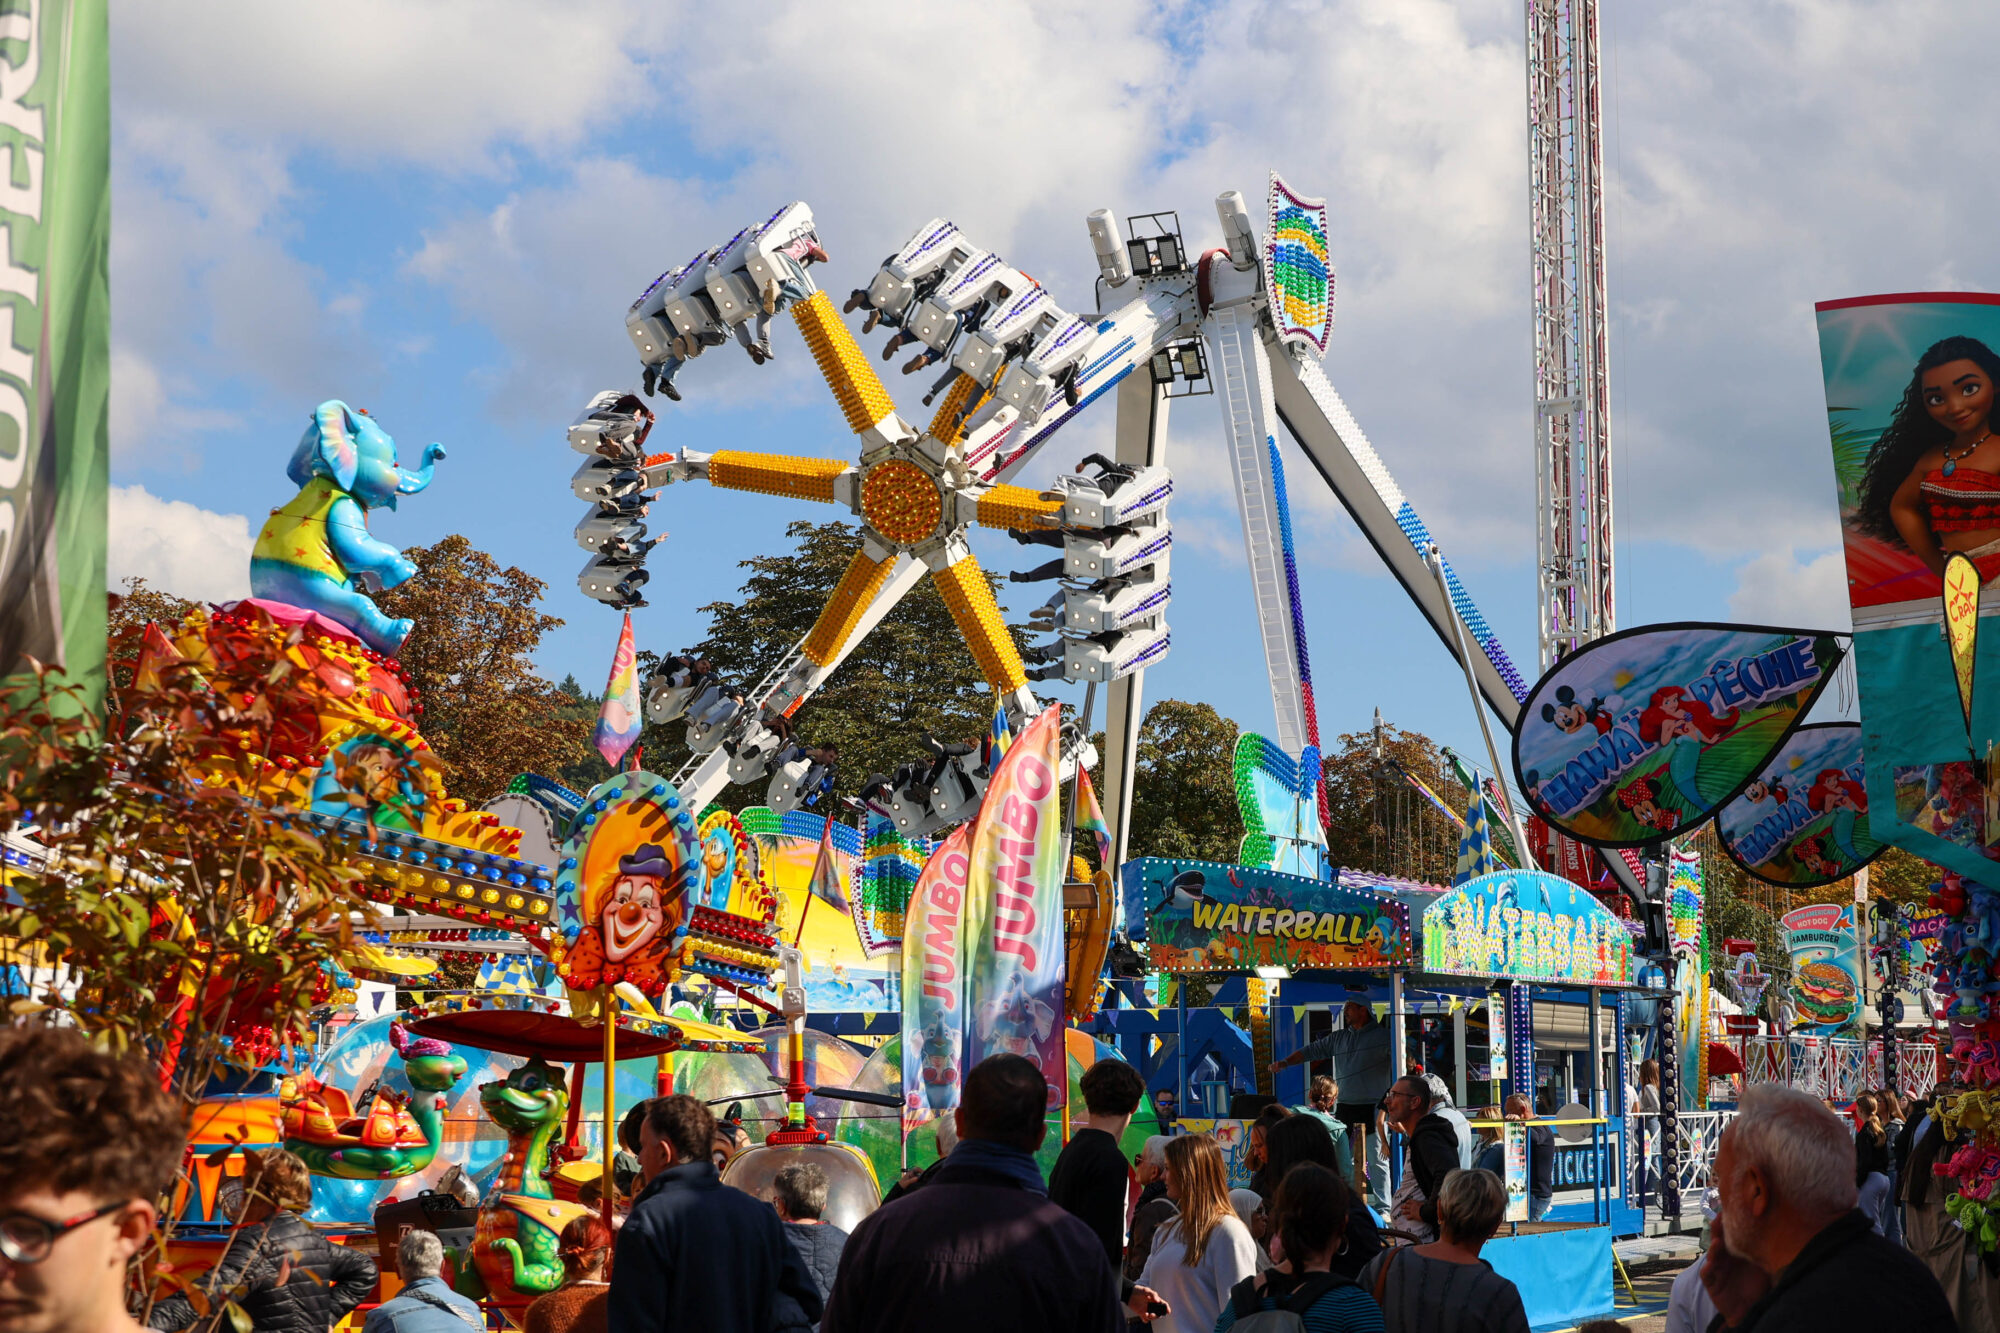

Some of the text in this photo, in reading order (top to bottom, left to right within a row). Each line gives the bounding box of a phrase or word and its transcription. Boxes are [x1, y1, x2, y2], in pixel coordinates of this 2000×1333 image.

[1689, 637, 1821, 715] PÊCHE
[993, 753, 1052, 973] JUMBO
[922, 852, 968, 1010] JUMBO
[1192, 900, 1365, 945] WATERBALL
[1454, 897, 1618, 973] WATERBALL
[1791, 933, 1840, 944] HAMBURGER
[1797, 917, 1828, 928] HOT DOG
[1909, 917, 1949, 936] NACK
